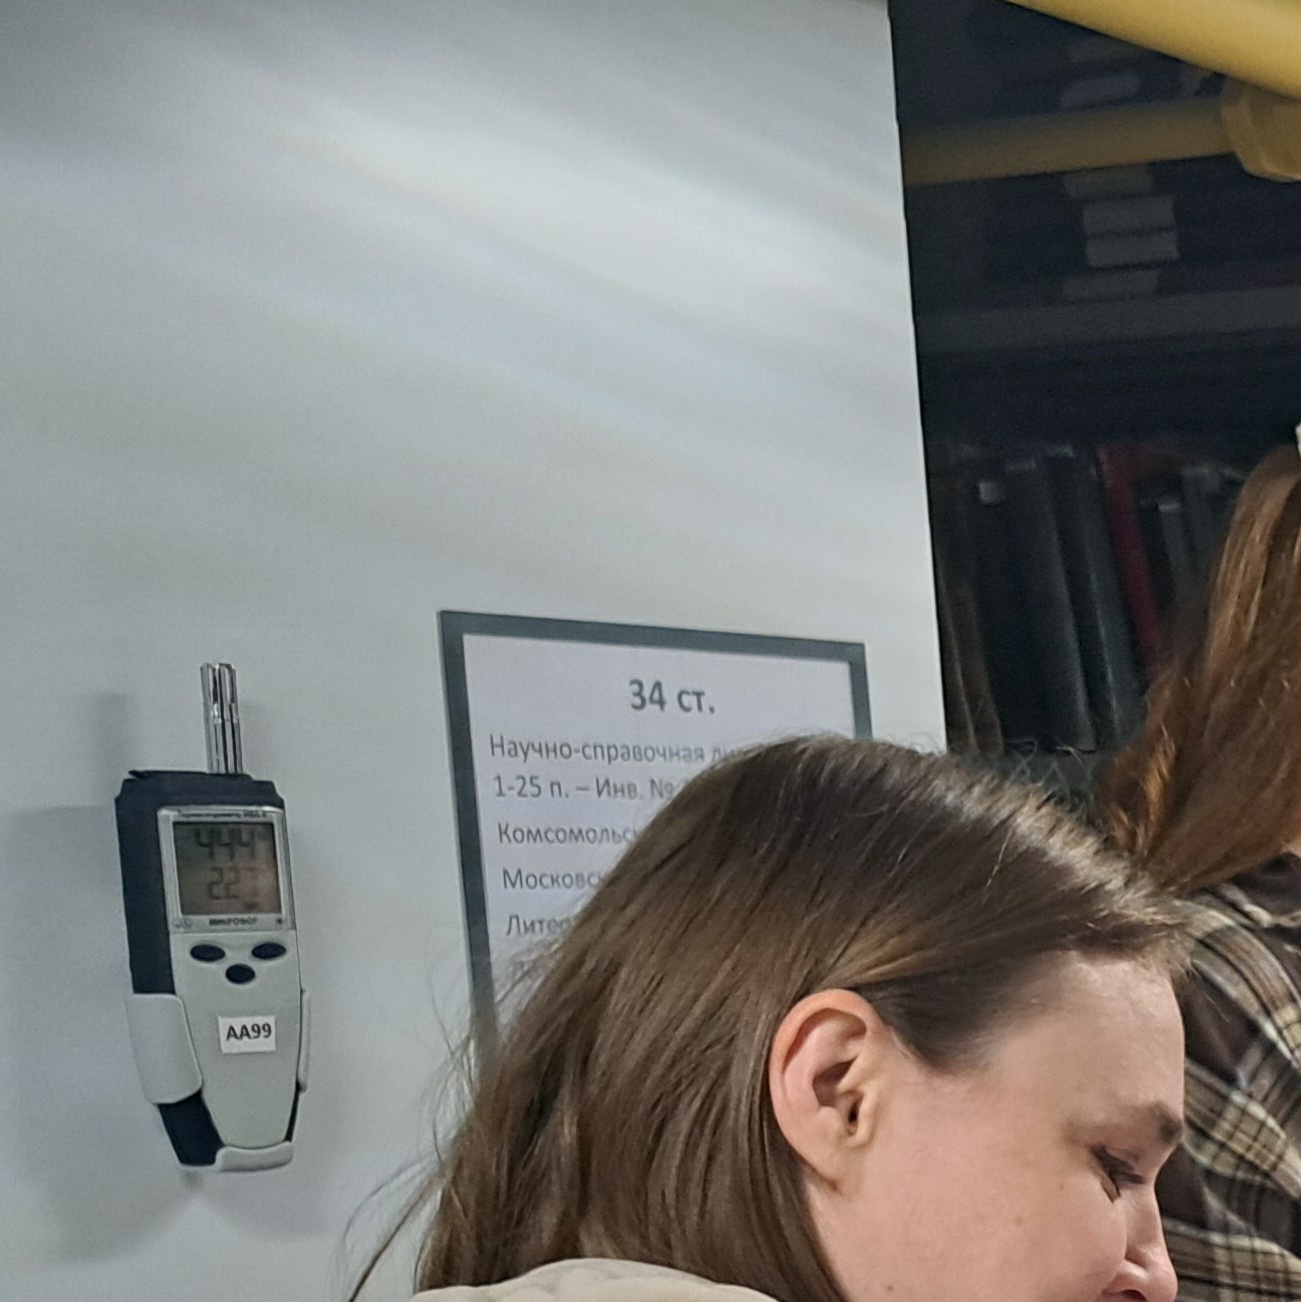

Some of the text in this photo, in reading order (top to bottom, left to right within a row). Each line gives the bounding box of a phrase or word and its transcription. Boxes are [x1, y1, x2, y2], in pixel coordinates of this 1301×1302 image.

[629, 679, 715, 714] 34 ст.
[489, 734, 705, 765] Научно-справочная
[494, 775, 542, 798] 1-25
[549, 781, 569, 798] п.
[226, 1022, 272, 1041] AA99
